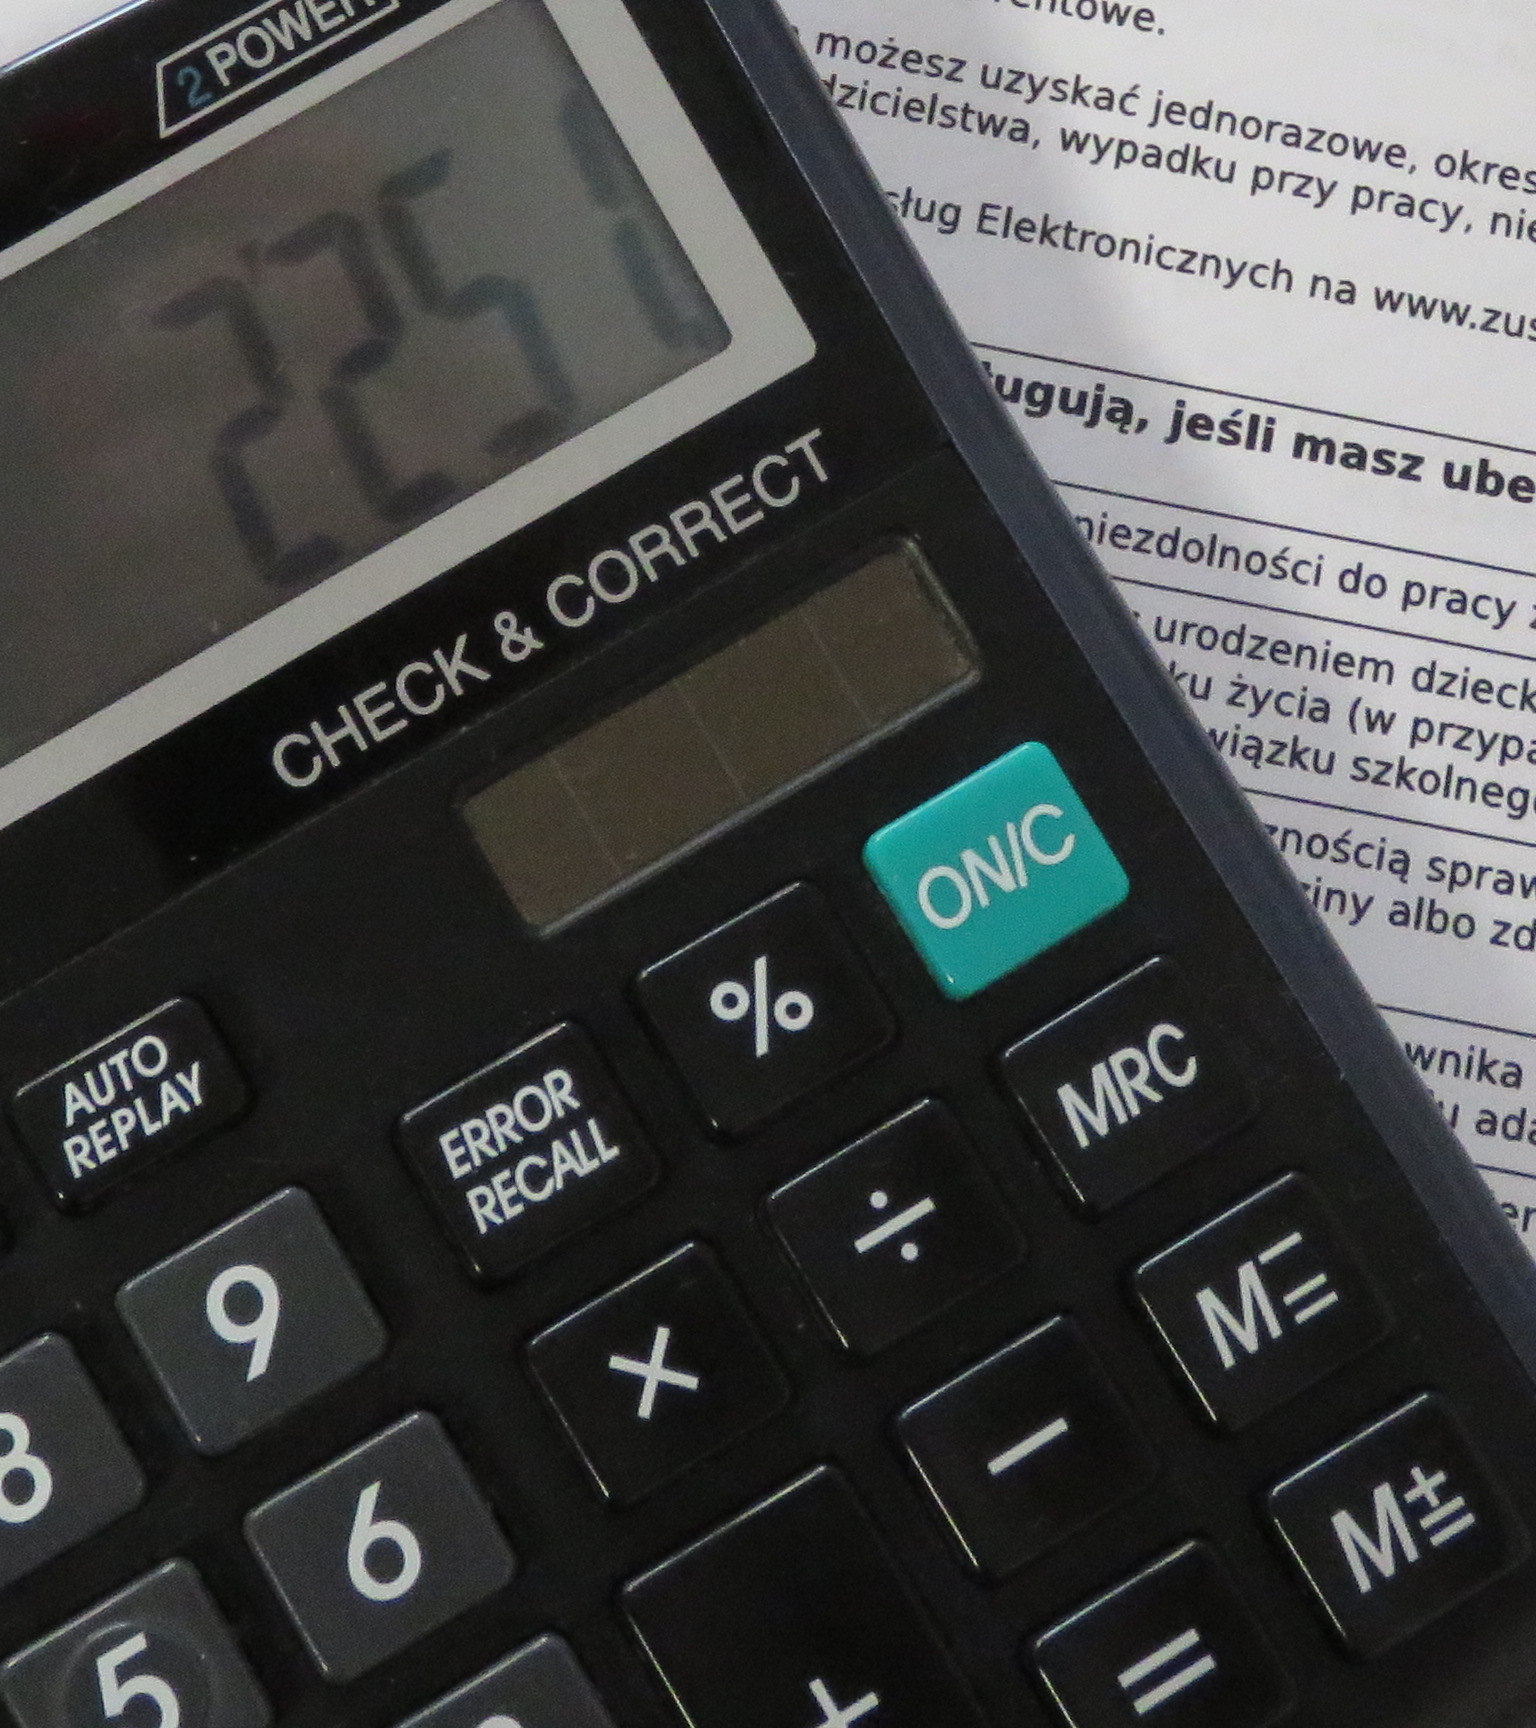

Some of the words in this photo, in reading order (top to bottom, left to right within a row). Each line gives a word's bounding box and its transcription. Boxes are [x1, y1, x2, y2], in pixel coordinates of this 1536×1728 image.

[981, 64, 1139, 116] uzyskać
[1148, 90, 1416, 174] jednorazowe,
[151, 84, 726, 587] 2251
[1164, 399, 1276, 453] jeśli
[1292, 432, 1424, 482] masz
[272, 634, 491, 788] CHECK
[493, 609, 544, 663] &
[546, 427, 832, 629] CORRECT
[1339, 562, 1387, 599] do
[1402, 580, 1516, 630] pracy
[916, 802, 1076, 930] ON/C
[62, 1034, 168, 1127] AUTO
[62, 1061, 205, 1179] REPLAY
[437, 1068, 581, 1180] ERROR
[1058, 1023, 1198, 1150] MRC
[467, 1118, 619, 1234] RECALL
[206, 1265, 280, 1382] 9
[347, 1481, 422, 1601] 6
[95, 1633, 179, 1728] 5
